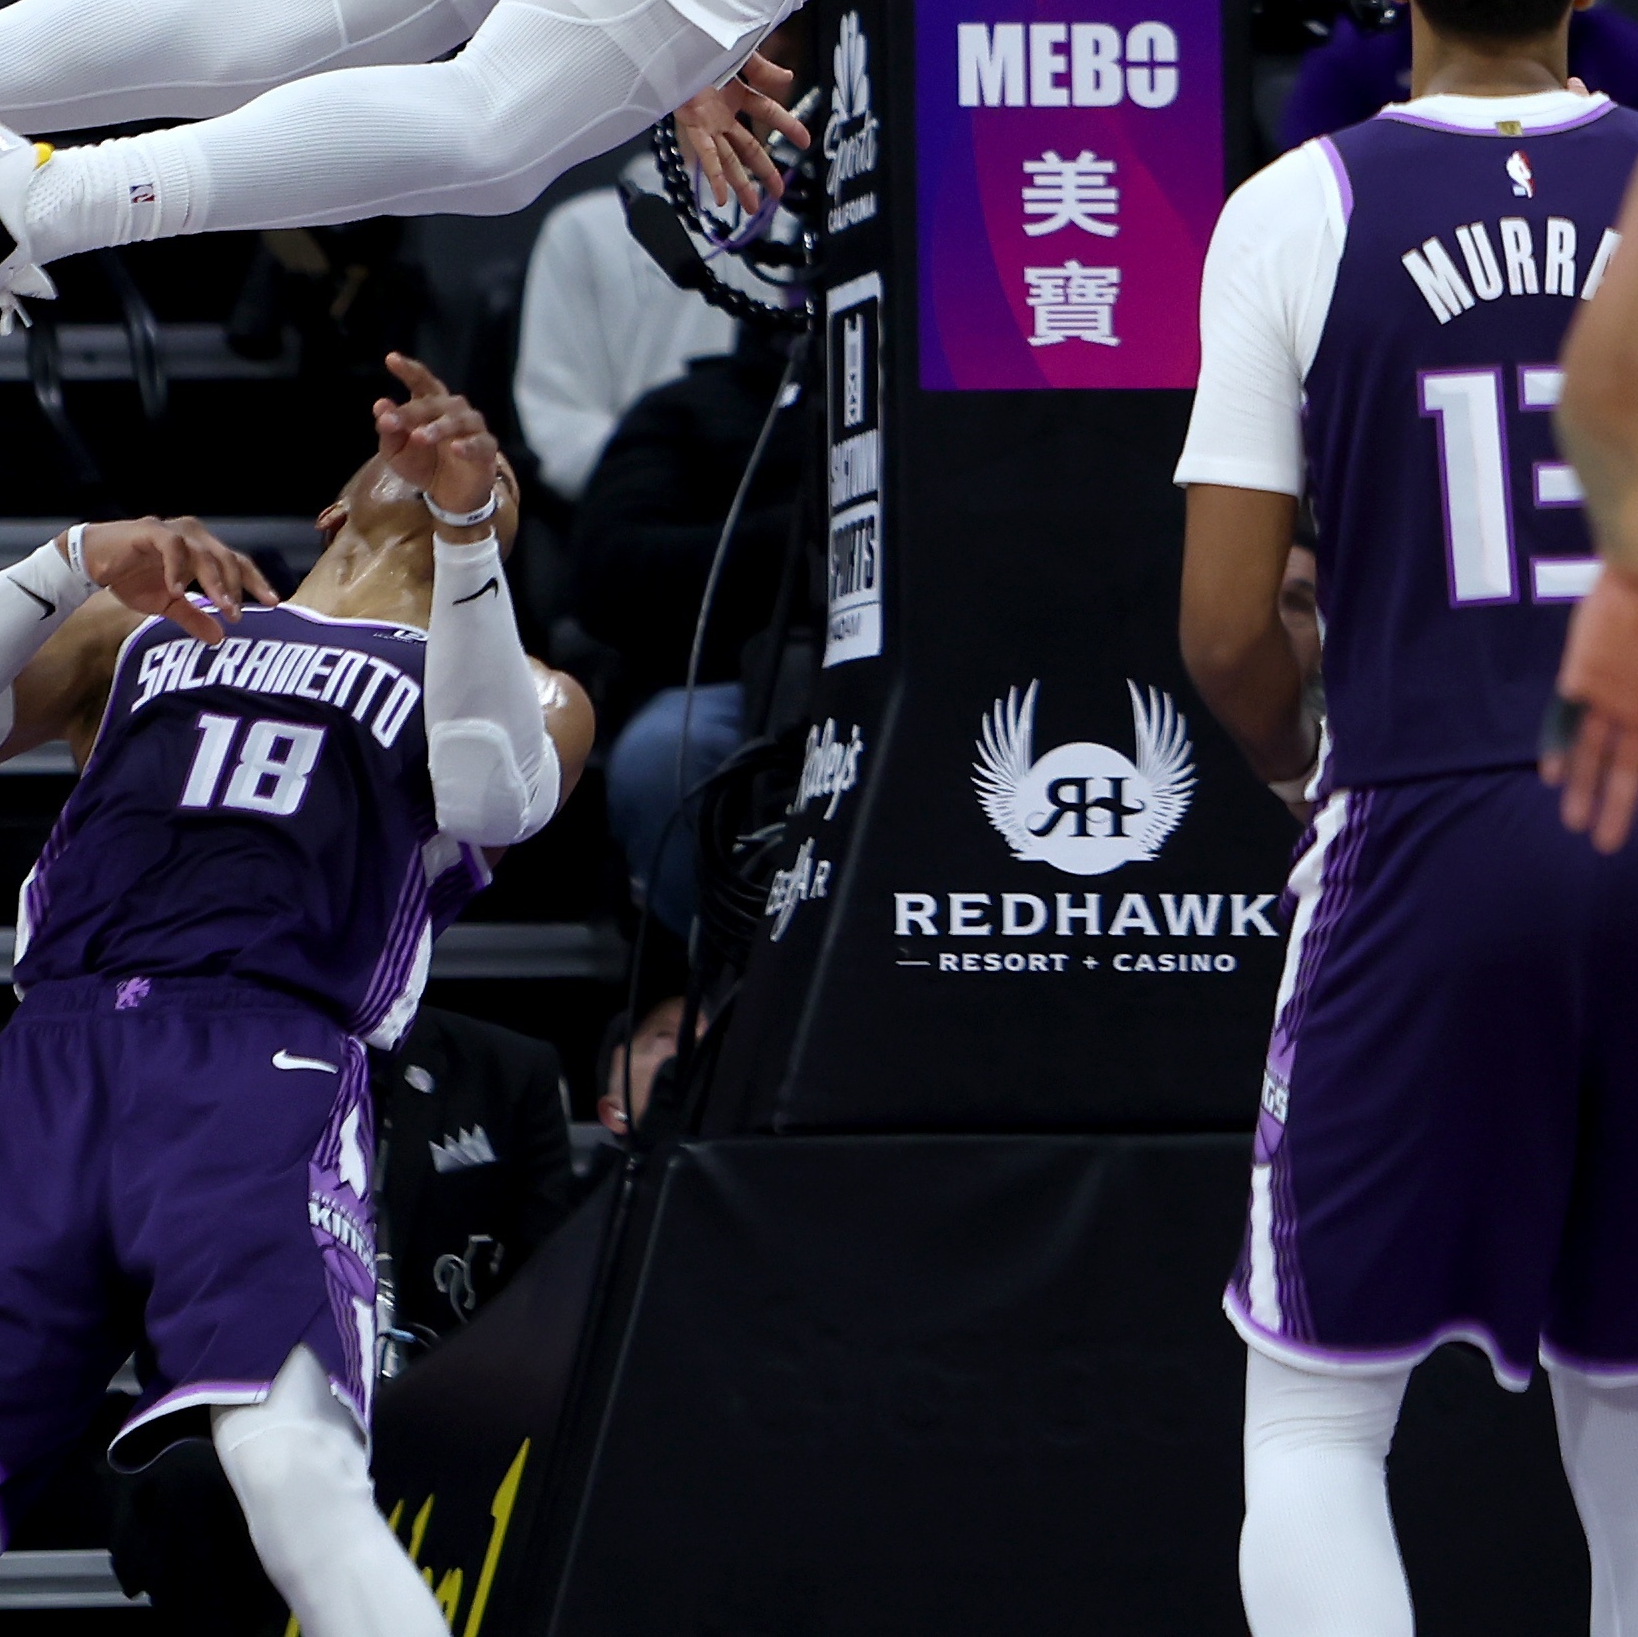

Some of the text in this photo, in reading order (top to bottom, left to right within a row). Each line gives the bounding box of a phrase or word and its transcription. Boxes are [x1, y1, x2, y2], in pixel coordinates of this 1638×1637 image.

[957, 20, 1180, 109] MEBO
[1021, 149, 1121, 349] 美寶
[1401, 215, 1622, 326] MURRA
[130, 639, 422, 751] SACRAMENTO
[177, 713, 329, 817] 18
[892, 892, 1280, 938] REDHAWK
[938, 953, 1069, 973] RESORT
[1111, 953, 1238, 973] CASINO
